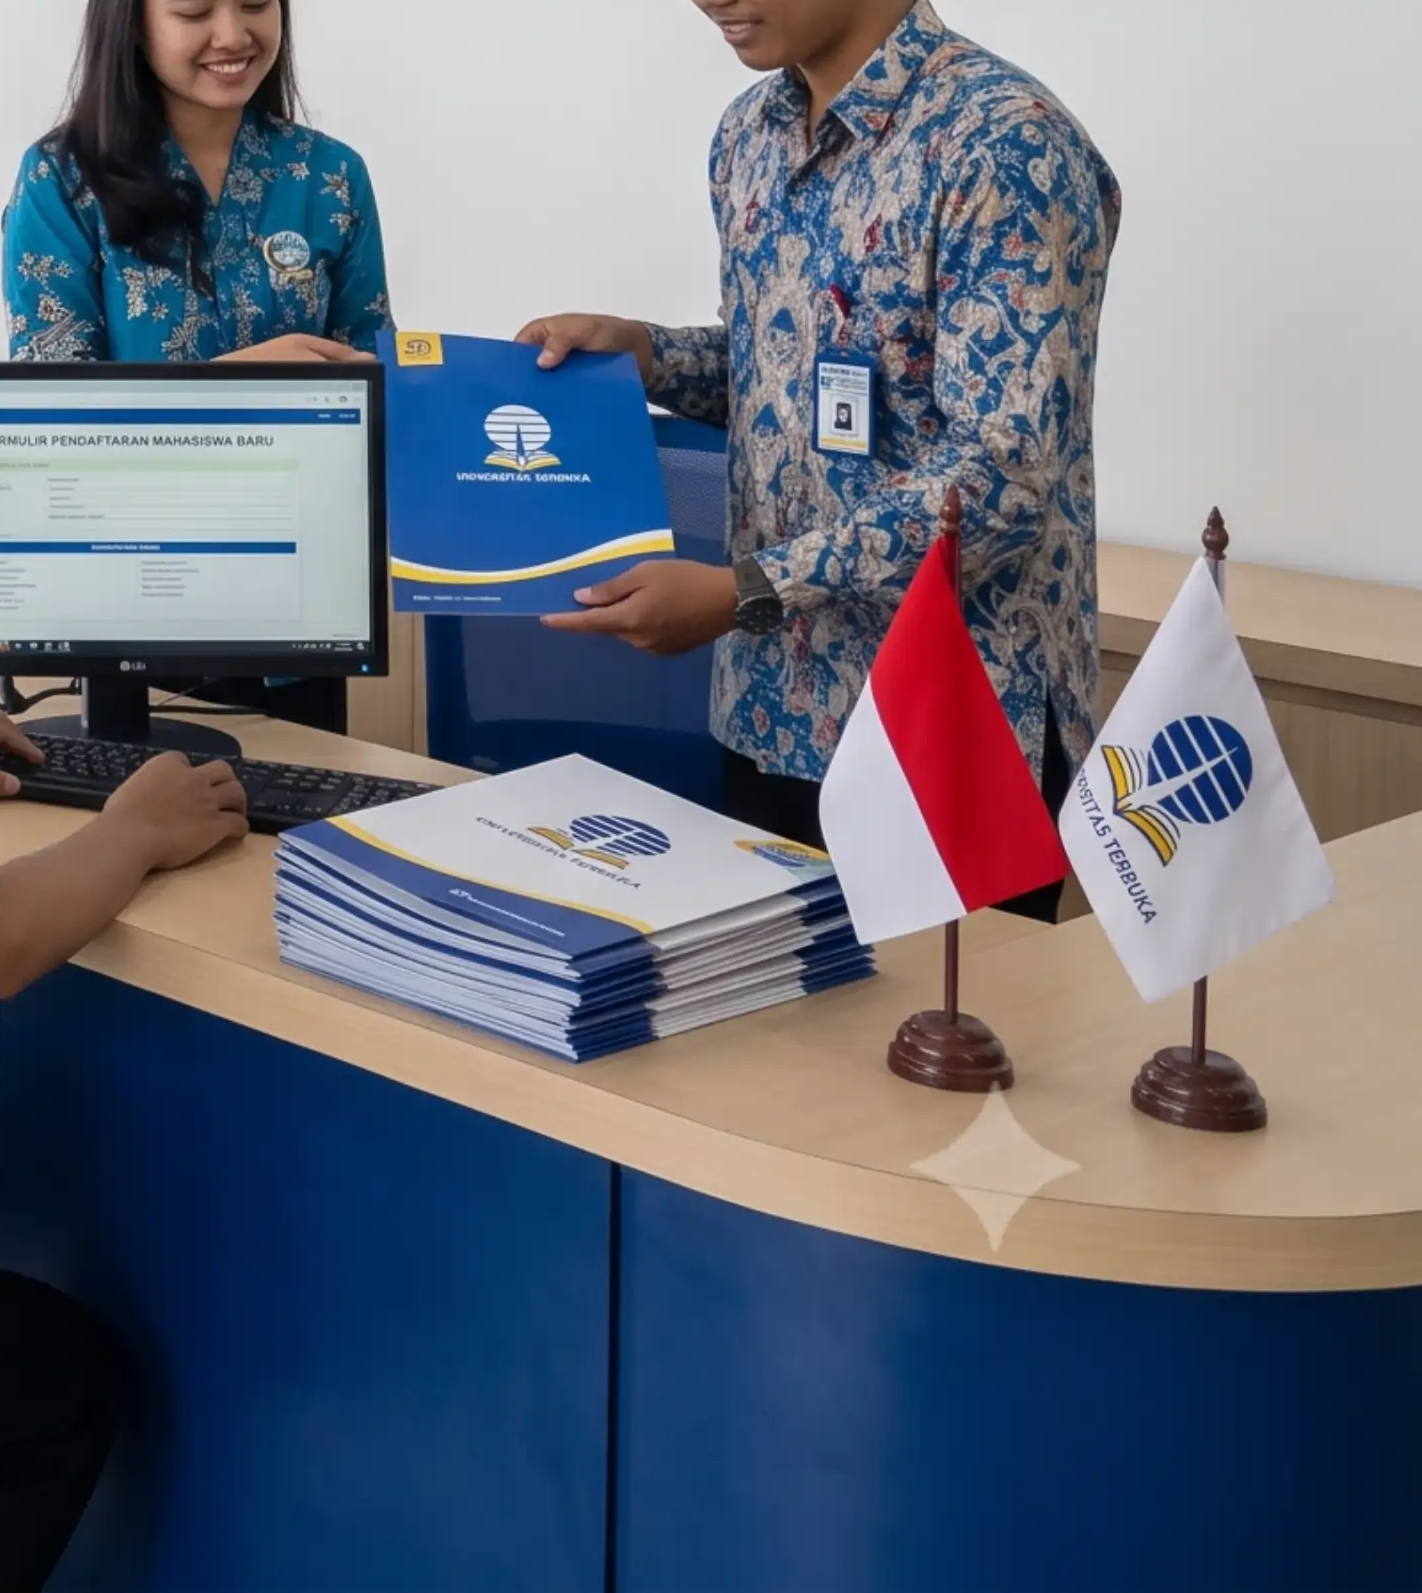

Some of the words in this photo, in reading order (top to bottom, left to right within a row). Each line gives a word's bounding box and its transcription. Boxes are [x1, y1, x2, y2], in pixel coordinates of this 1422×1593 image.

[152, 434, 233, 448] MAHASISWA
[236, 434, 275, 448] BARU
[1104, 837, 1158, 925] TERBUKA
